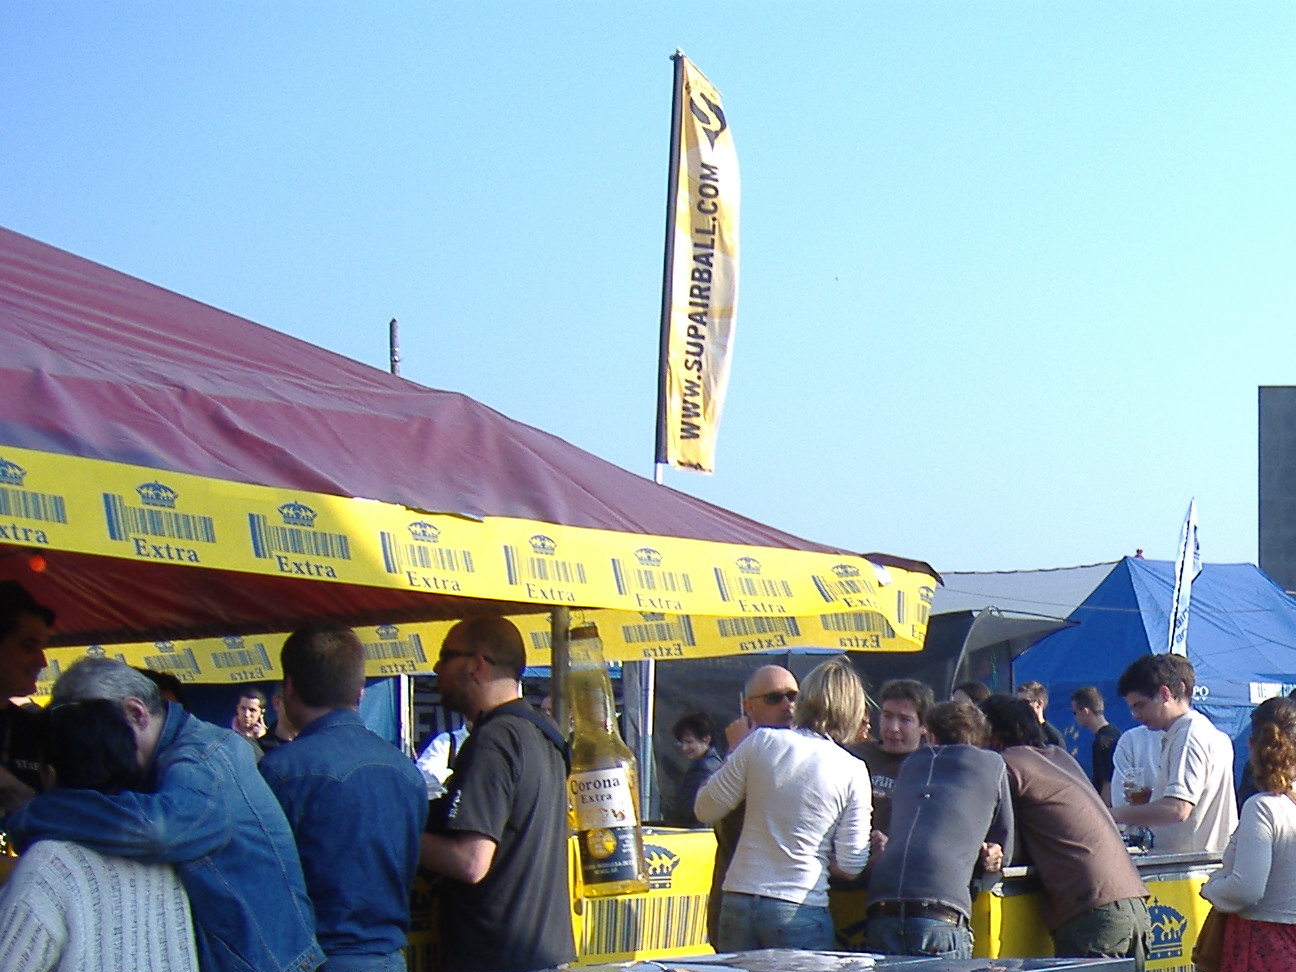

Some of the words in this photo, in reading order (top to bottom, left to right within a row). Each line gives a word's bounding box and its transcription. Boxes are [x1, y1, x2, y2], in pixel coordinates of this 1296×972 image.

[679, 162, 720, 441] WWW.SUPAIRBALL.COM
[0, 523, 49, 544] xtra
[133, 537, 201, 563] Extra
[276, 554, 338, 579] Extra
[406, 570, 463, 593] Extra
[525, 582, 577, 603] Extra
[636, 593, 683, 611] Extra
[738, 599, 788, 615] Extra
[570, 777, 621, 796] Corona
[580, 794, 613, 805] Extra
